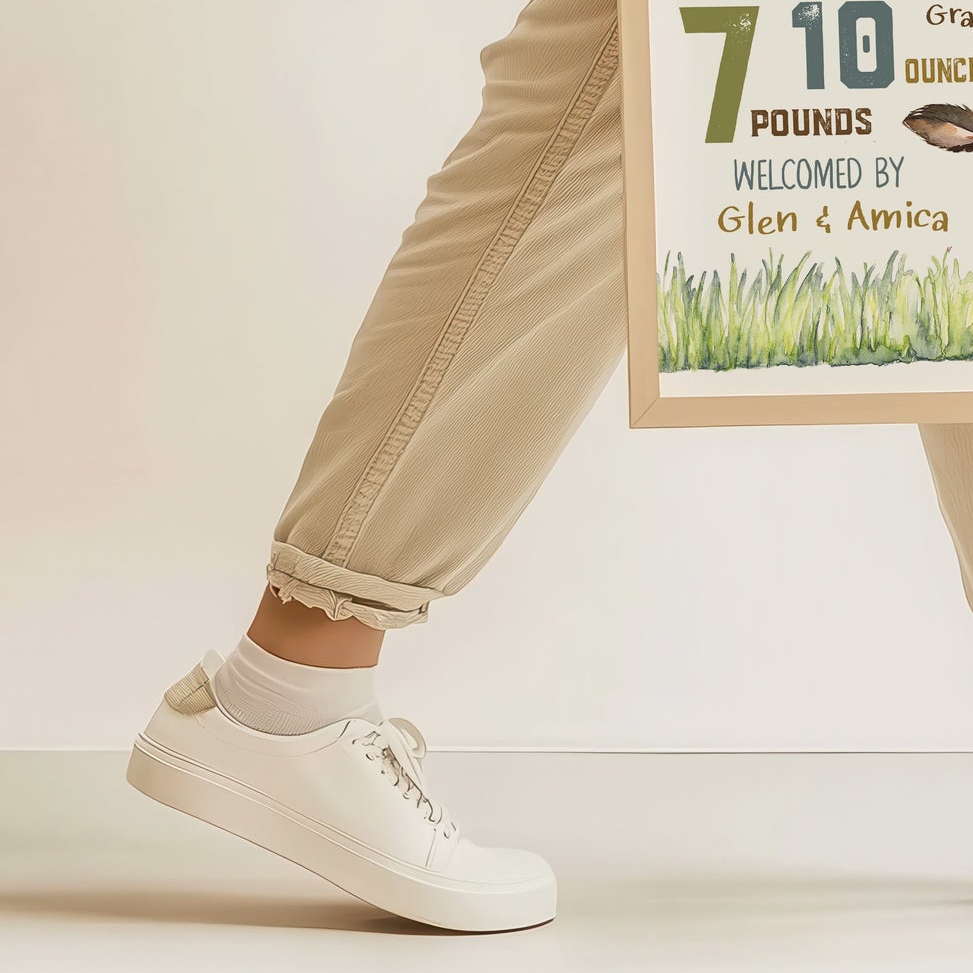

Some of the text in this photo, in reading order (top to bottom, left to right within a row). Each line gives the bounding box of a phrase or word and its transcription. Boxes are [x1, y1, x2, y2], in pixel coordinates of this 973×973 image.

[791, 0, 896, 90] 10
[678, 5, 760, 144] 7
[750, 107, 873, 138] POUNDS
[733, 155, 905, 192] WELCOMED BY
[717, 199, 949, 236] Glen & Amica
